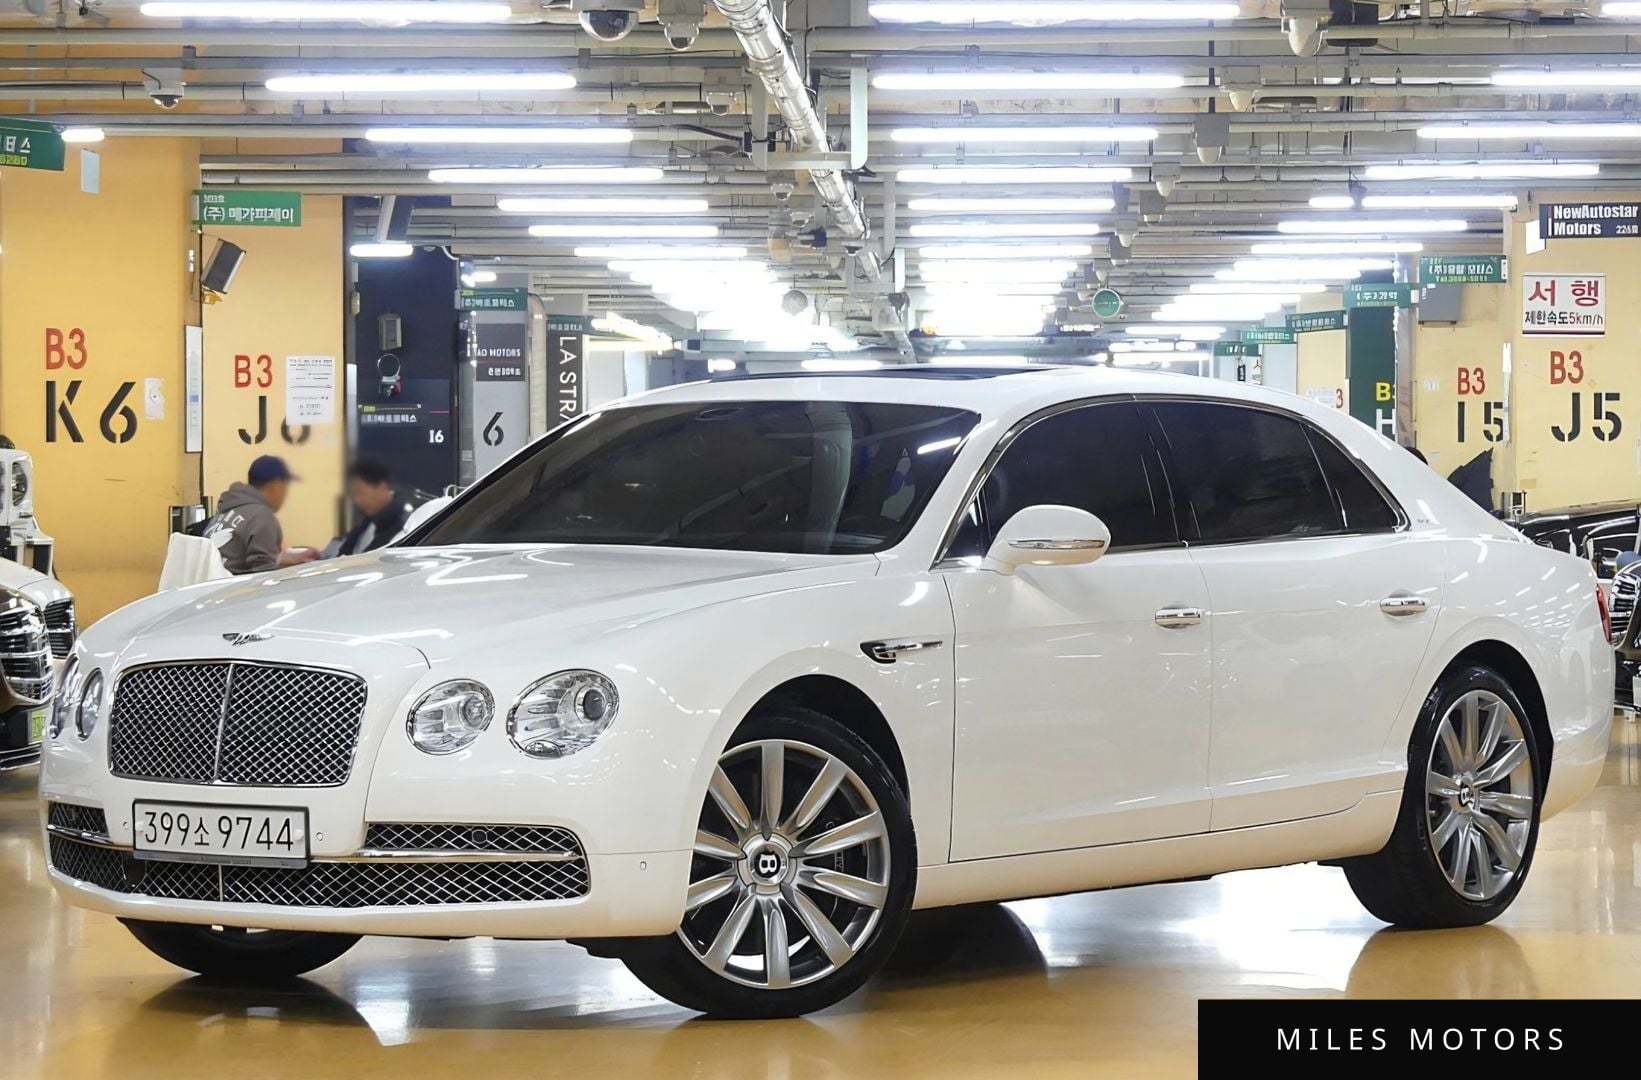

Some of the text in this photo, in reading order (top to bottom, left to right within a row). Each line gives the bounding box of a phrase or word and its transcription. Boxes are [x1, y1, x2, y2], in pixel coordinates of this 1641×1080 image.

[1553, 205, 1639, 219] NewAutostar
[1553, 222, 1602, 236] Motors
[1525, 310, 1604, 325] 제한속도5km/h
[46, 328, 88, 370] B3
[559, 336, 577, 365] LA
[234, 354, 273, 388] B3
[1457, 367, 1486, 395] B3
[1550, 350, 1585, 385] B3
